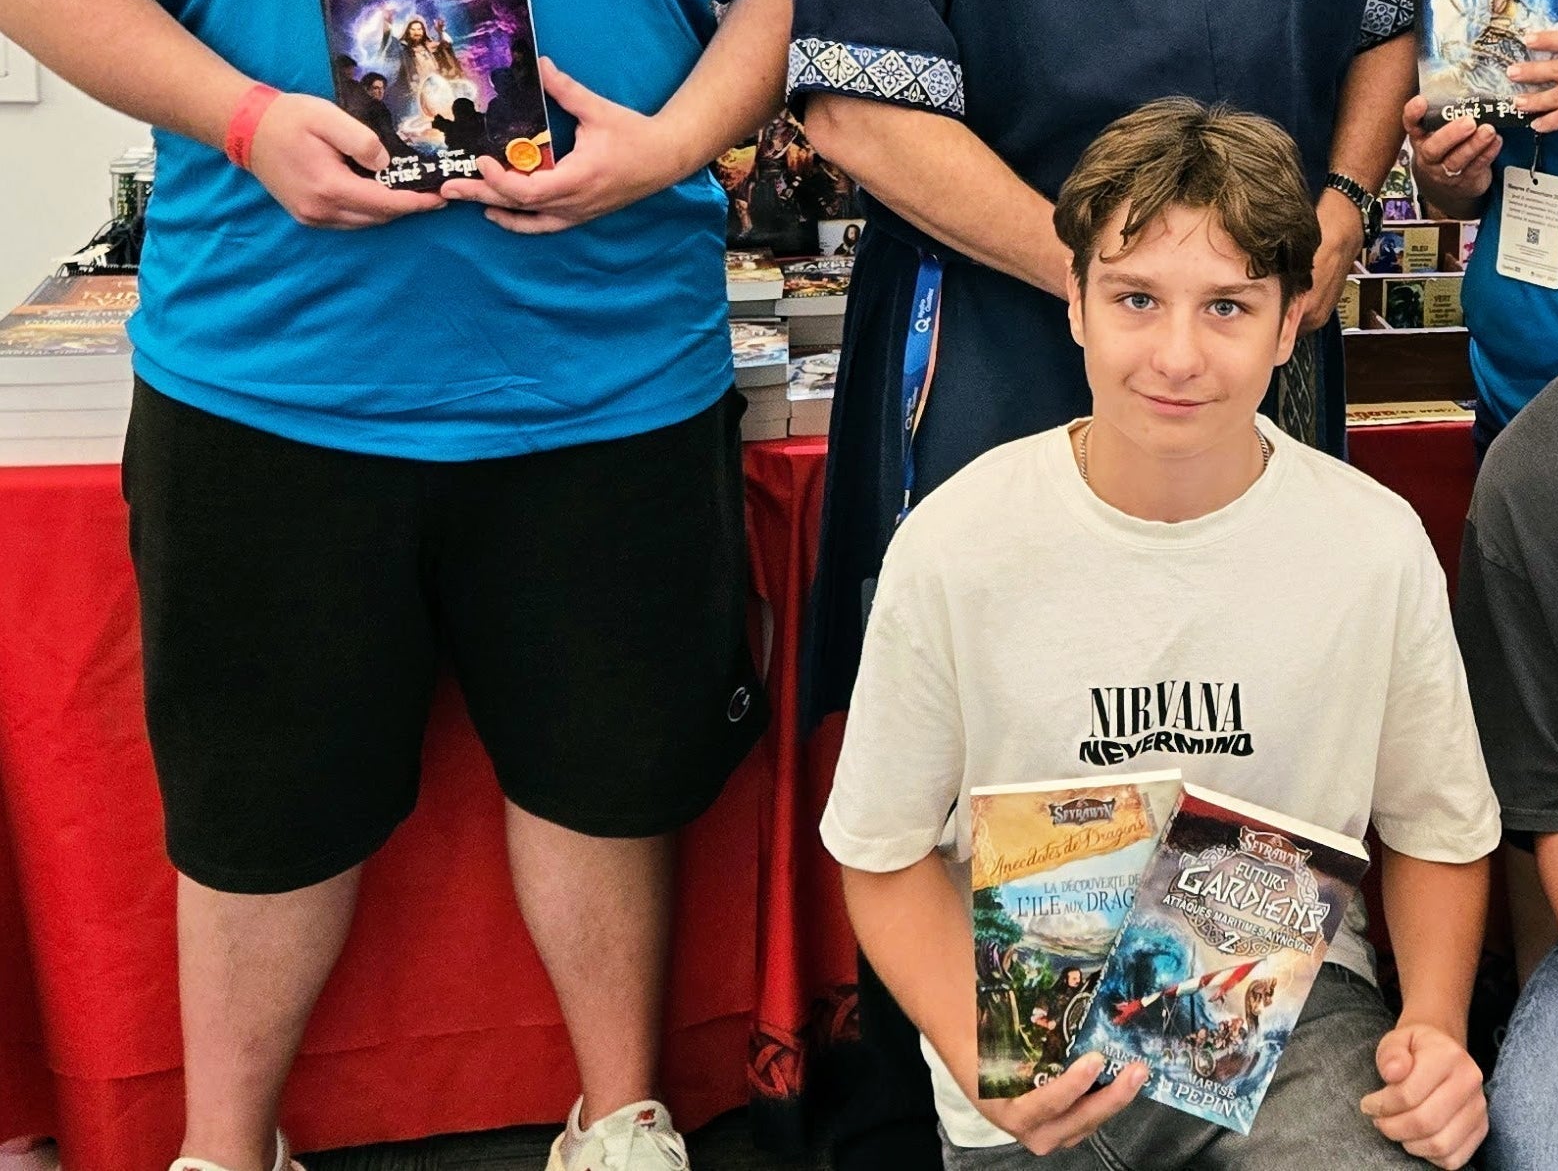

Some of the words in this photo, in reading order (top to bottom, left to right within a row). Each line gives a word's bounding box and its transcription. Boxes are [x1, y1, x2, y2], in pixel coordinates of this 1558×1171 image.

[439, 155, 477, 177] Pepi
[1088, 681, 1245, 738] NIRVANA
[1079, 731, 1254, 766] NEVERMIND
[990, 843, 1061, 878] Anecdotes
[1064, 836, 1079, 855] de
[1078, 820, 1145, 851] Dragons
[1043, 882, 1057, 894] LA
[1234, 862, 1288, 892] FUTURS
[1065, 899, 1084, 914] AUX
[1087, 887, 1134, 912] DRAG
[1162, 894, 1214, 918] ATTAQUES
[1213, 911, 1264, 936] MARITIMES
[1177, 865, 1324, 934] GARDIENS
[1218, 930, 1241, 954] 2
[1175, 1084, 1235, 1118] PEPIN
[1187, 1072, 1237, 1100] MARYSE
